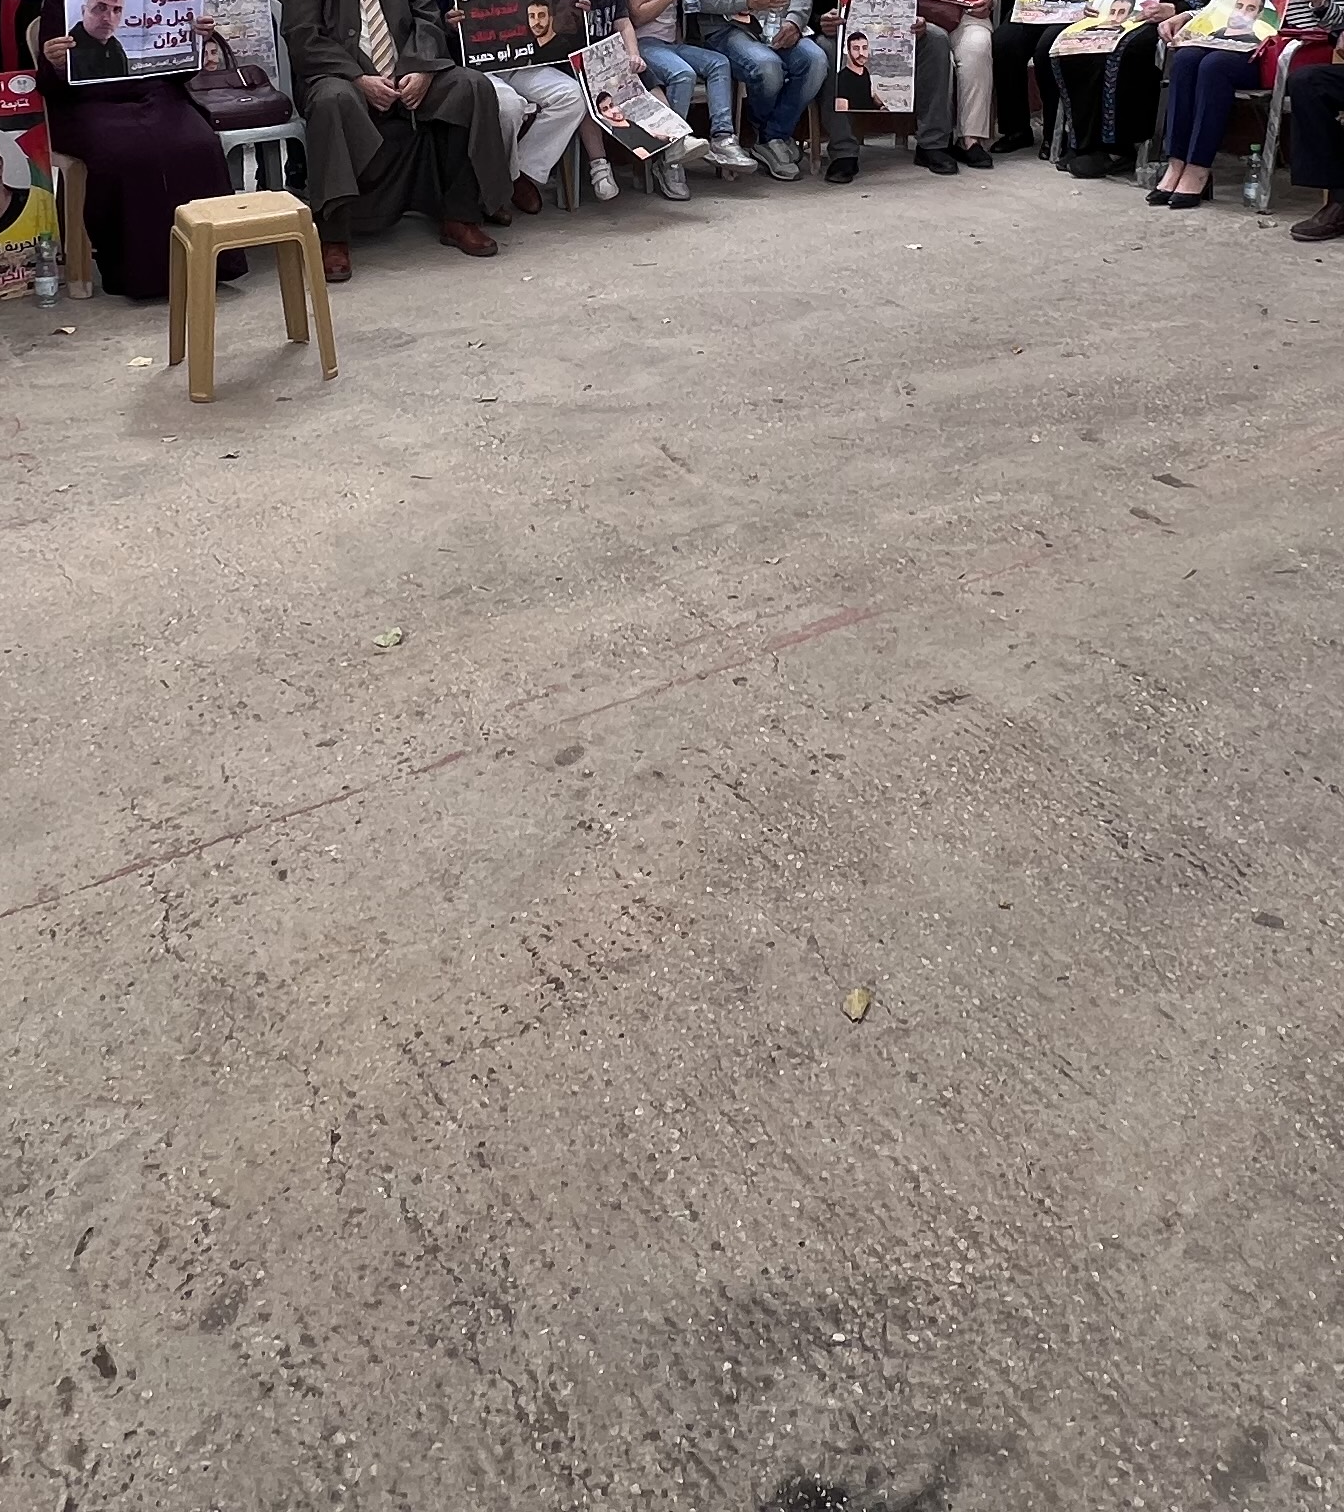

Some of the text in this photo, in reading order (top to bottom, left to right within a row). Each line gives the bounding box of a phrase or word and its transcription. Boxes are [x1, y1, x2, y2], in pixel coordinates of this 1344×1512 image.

[124, 8, 194, 29] قبل فوات
[154, 29, 193, 50] الأوان
[469, 43, 534, 65] ناصر أبو حميد
